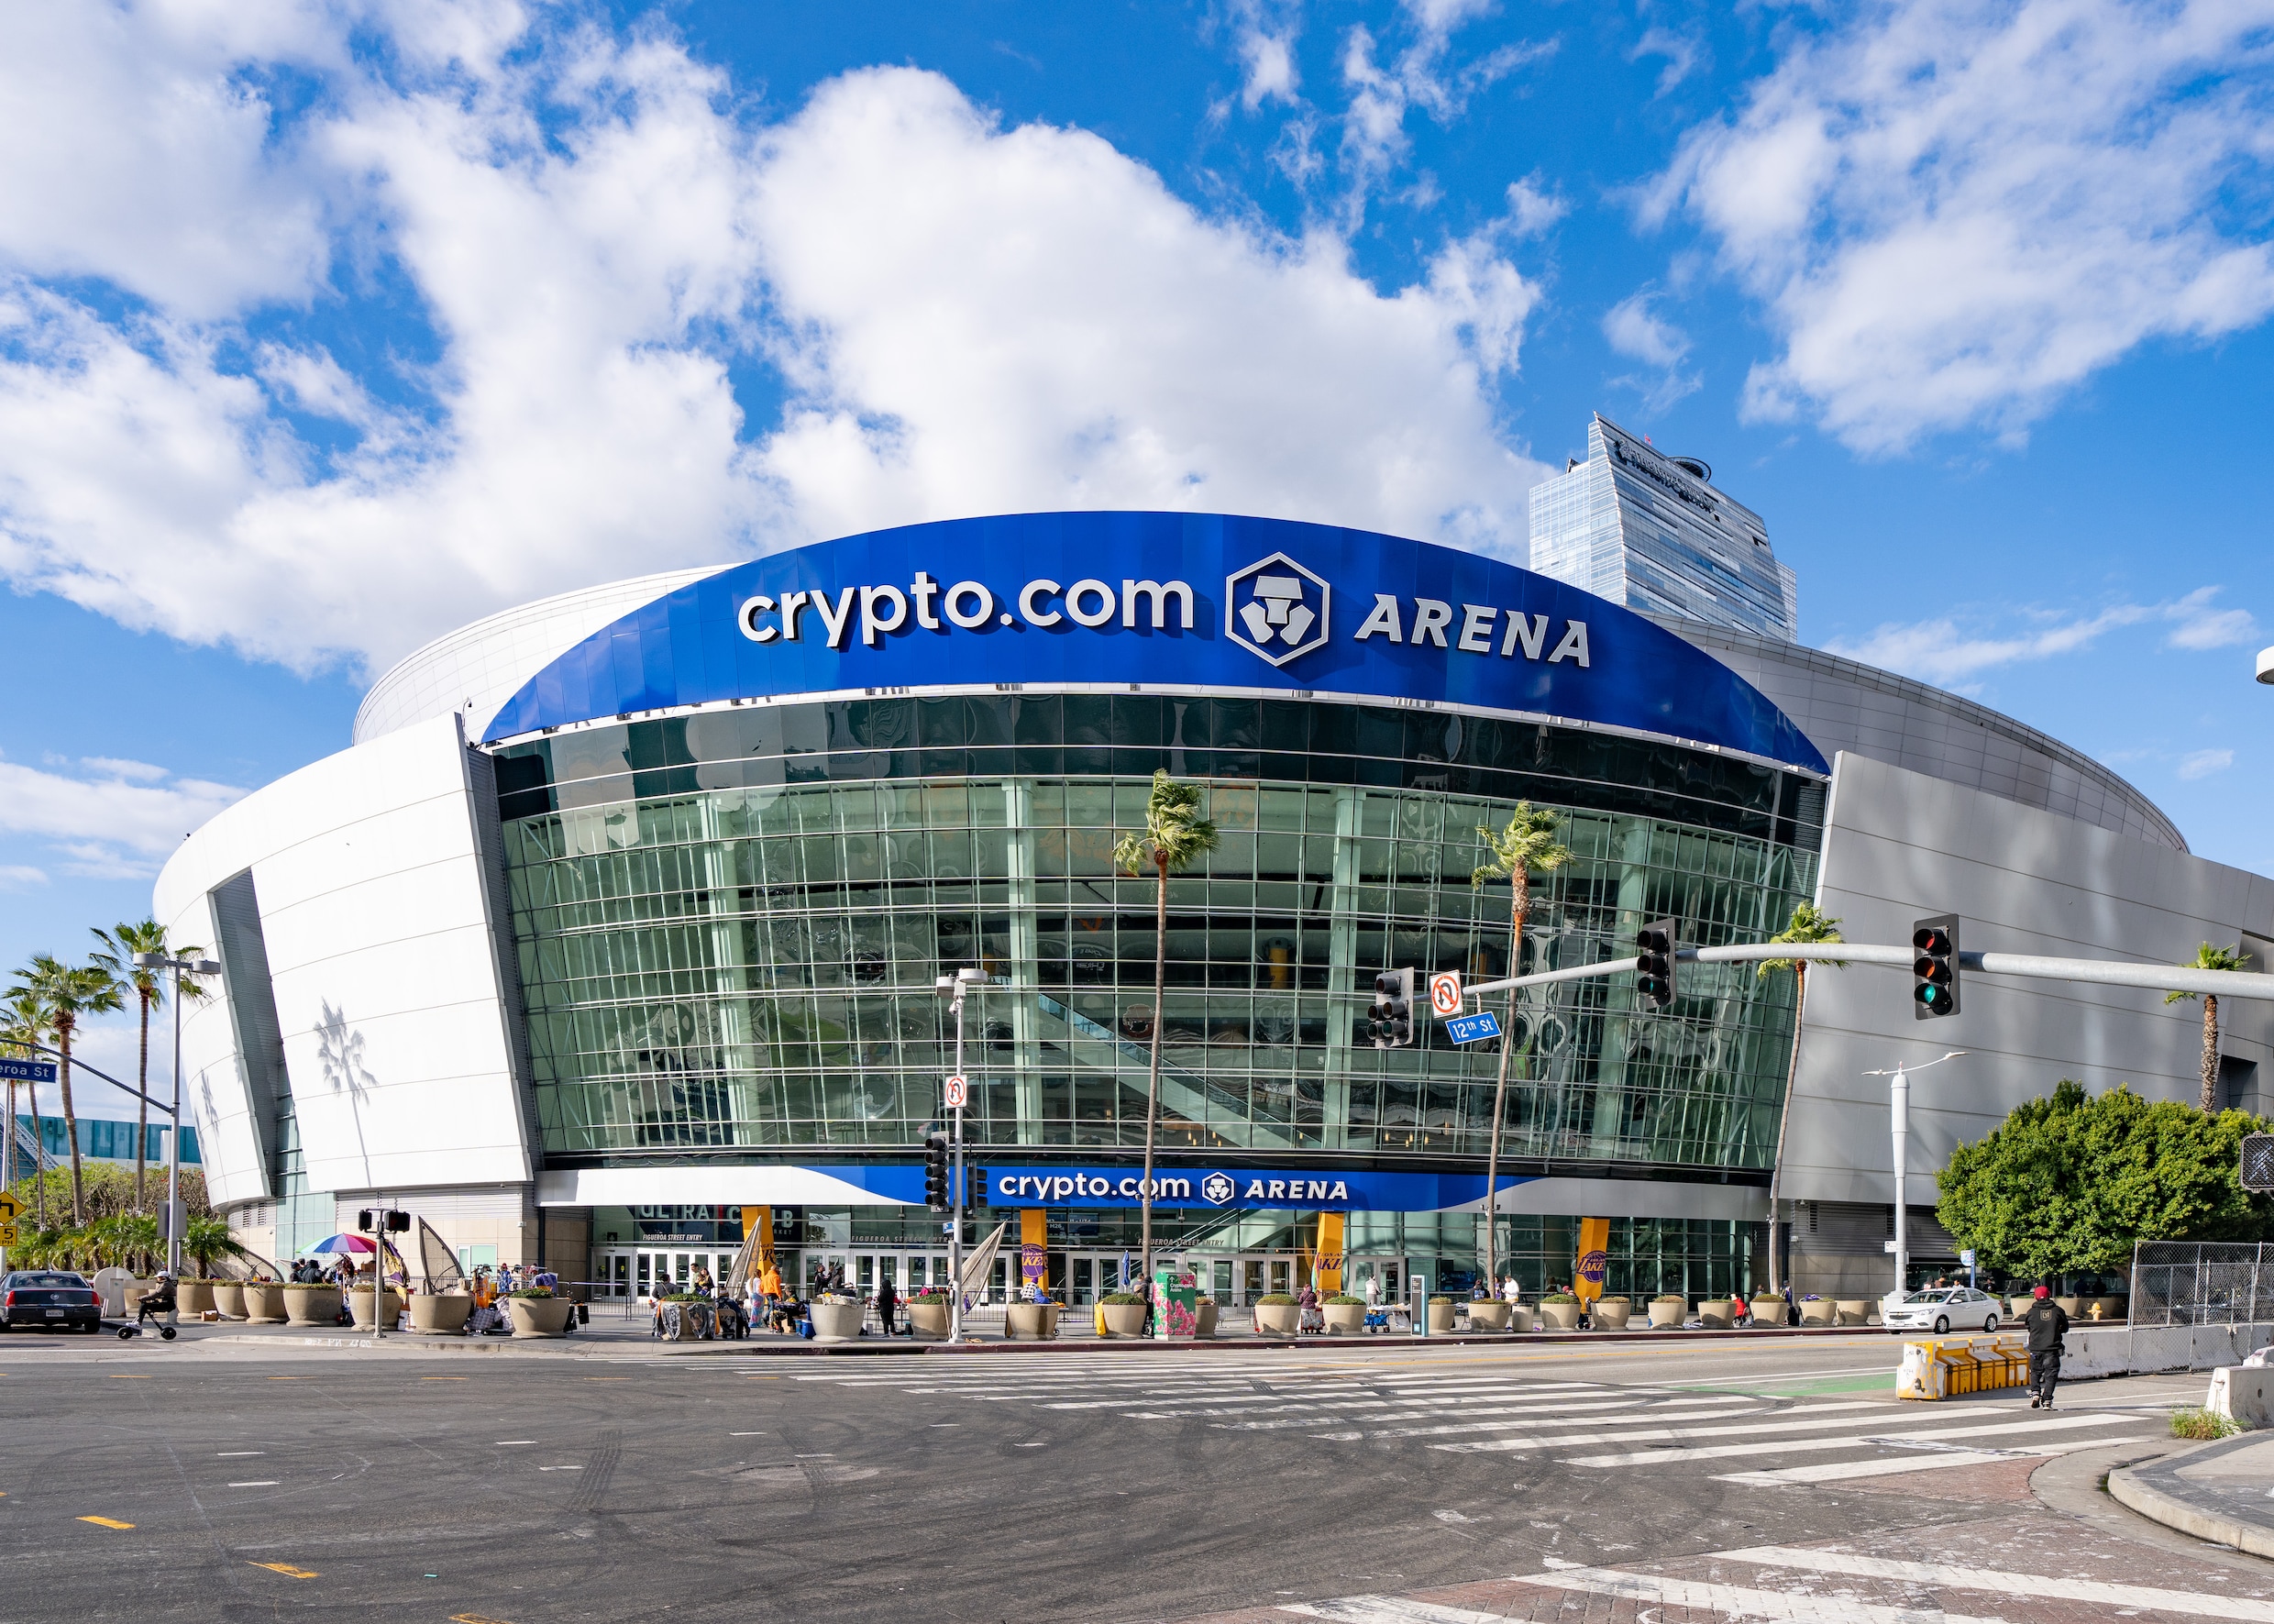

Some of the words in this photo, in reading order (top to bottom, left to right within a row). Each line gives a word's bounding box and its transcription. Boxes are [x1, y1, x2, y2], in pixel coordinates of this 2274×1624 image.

[737, 571, 1194, 647] crypto.com
[1353, 593, 1590, 668] ARENA
[1452, 1021, 1476, 1039] 12th
[1479, 1019, 1494, 1032] St
[34, 1066, 49, 1077] St
[999, 1173, 1189, 1199] crypto.com
[1244, 1179, 1348, 1199] ARENA
[642, 1205, 710, 1220] ULRA
[727, 1206, 793, 1228] CB
[1176, 1238, 1200, 1246] STREET
